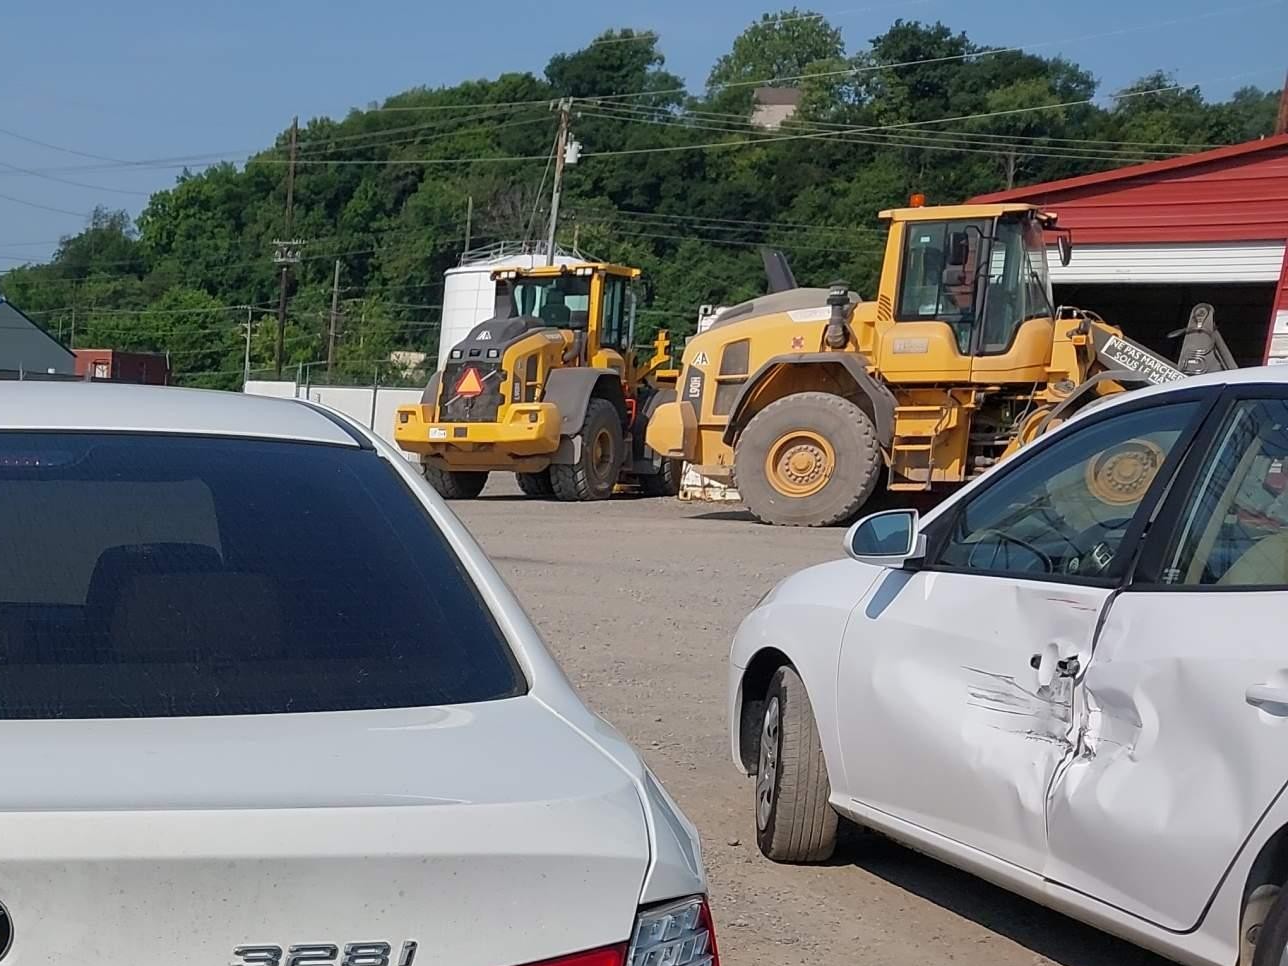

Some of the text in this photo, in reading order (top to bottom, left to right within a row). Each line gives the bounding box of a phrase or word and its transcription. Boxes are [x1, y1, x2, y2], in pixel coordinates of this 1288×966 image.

[1111, 339, 1125, 350] NE
[1124, 346, 1141, 360] PAS
[1114, 351, 1140, 368] SOUS
[688, 376, 702, 398] L90H
